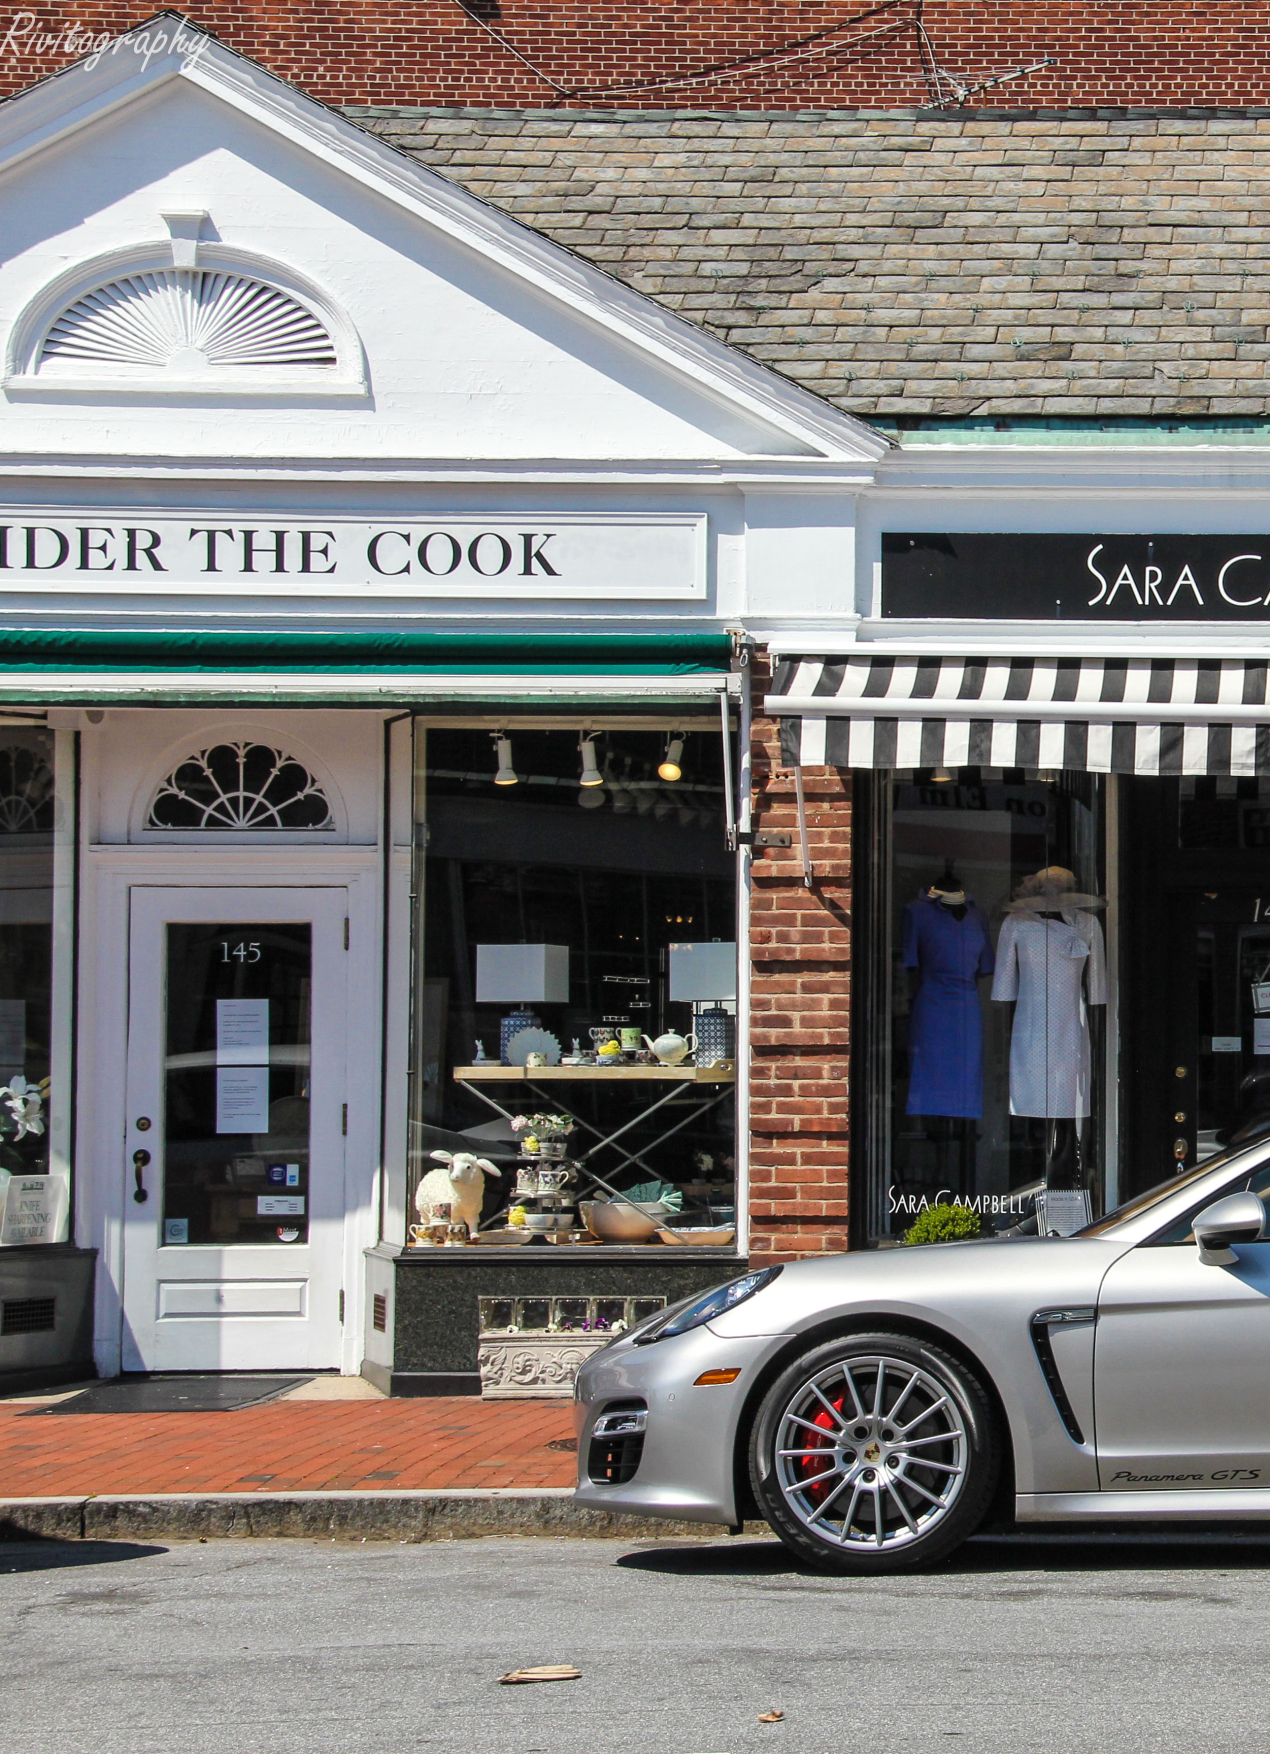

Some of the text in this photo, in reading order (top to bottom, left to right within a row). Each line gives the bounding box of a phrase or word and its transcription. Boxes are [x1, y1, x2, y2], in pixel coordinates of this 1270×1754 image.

[188, 527, 339, 575] THE
[366, 530, 563, 577] COOK
[1086, 543, 1205, 607] SARA
[220, 942, 261, 963] 145
[1110, 1469, 1262, 1482] Panamera GTS
